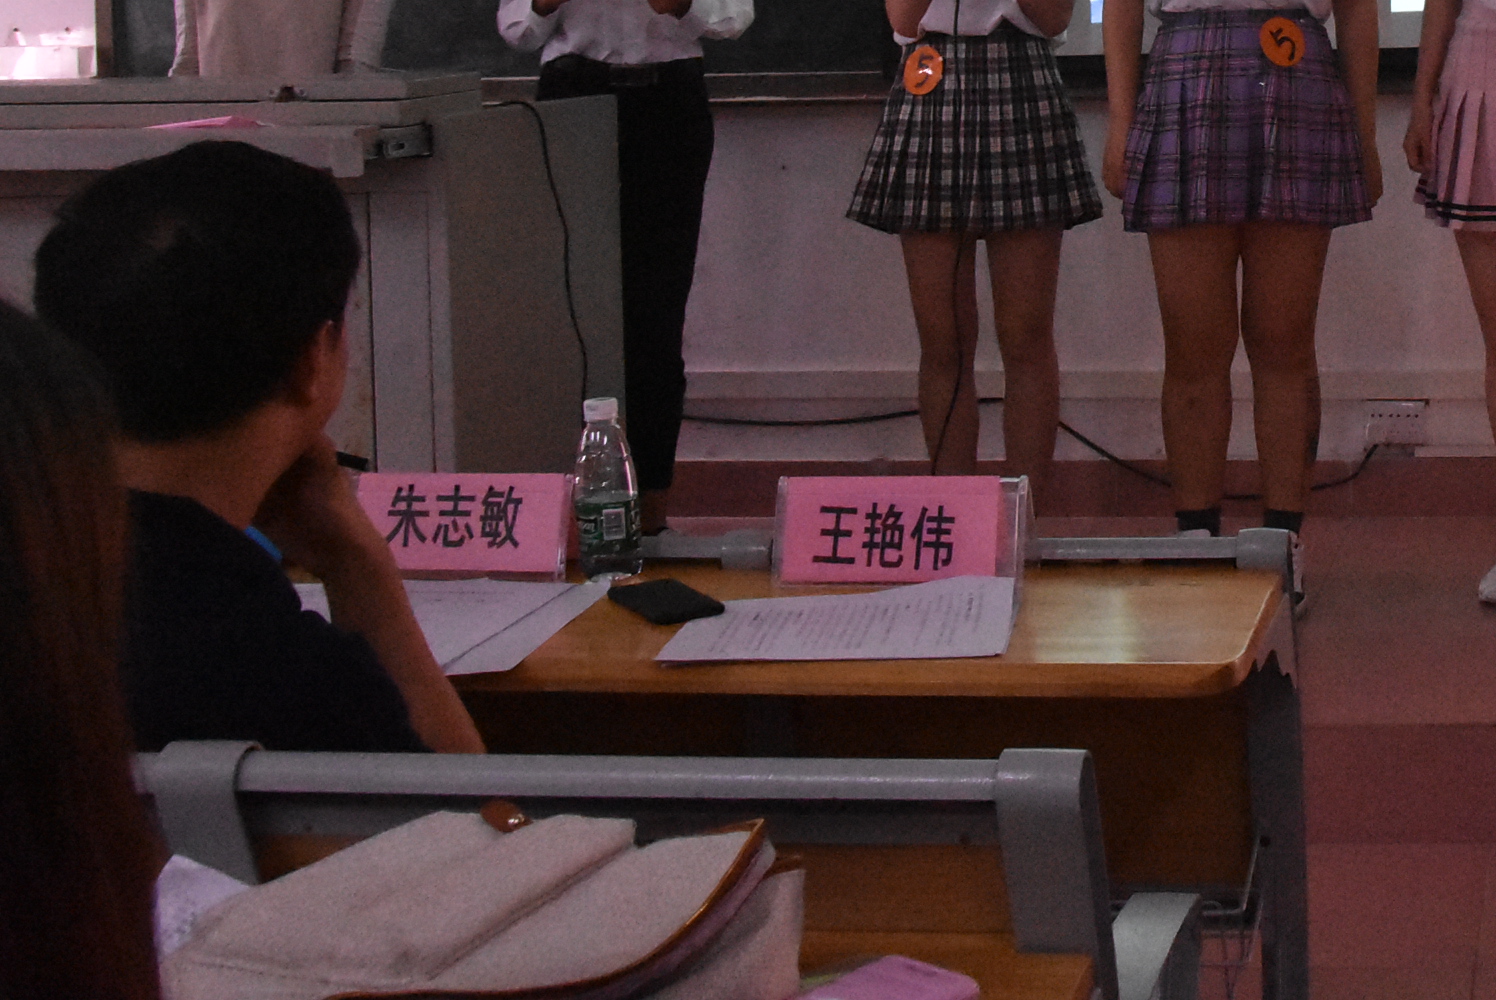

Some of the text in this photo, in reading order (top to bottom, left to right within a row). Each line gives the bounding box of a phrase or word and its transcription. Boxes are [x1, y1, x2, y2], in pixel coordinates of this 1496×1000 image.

[1269, 27, 1296, 62] 5
[386, 484, 523, 548] 朱志敏
[812, 502, 955, 571] 王艳伟
